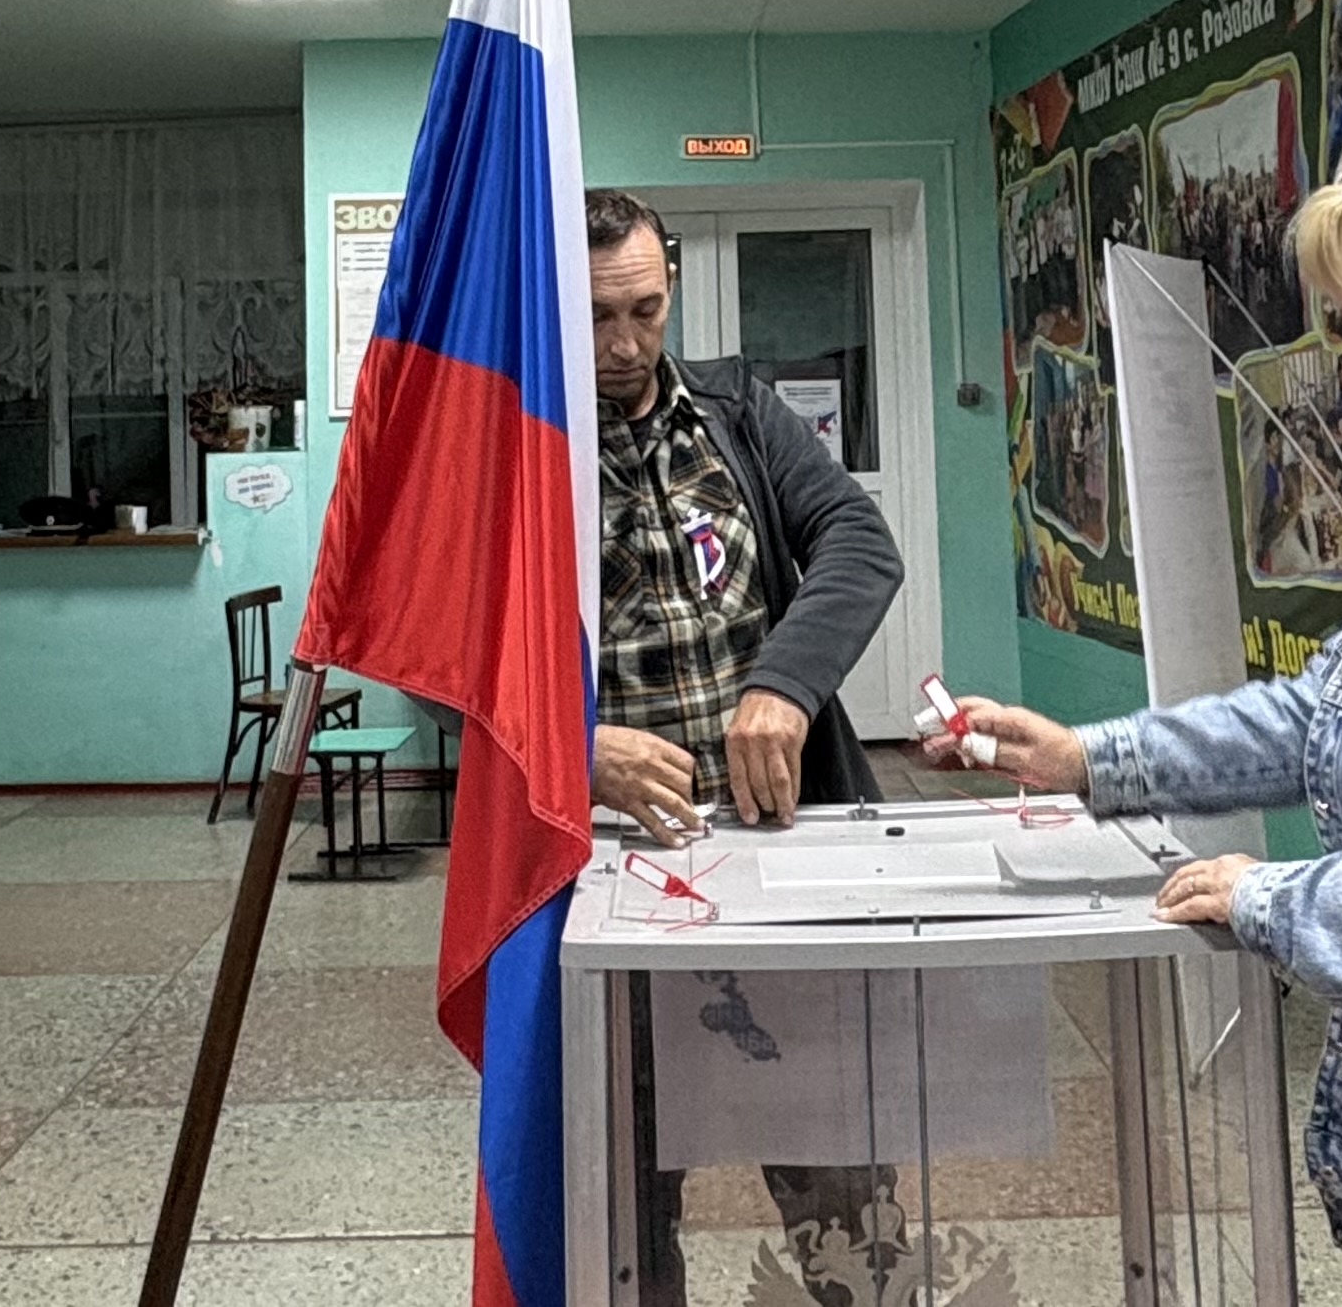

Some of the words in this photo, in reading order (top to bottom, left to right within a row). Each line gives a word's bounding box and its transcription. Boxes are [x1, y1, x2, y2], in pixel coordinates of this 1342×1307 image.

[1114, 46, 1145, 96] СОШ
[1147, 39, 1166, 81] №
[1167, 27, 1181, 70] 9
[686, 139, 748, 155] ВЫХОД
[335, 203, 401, 231] ЗВО
